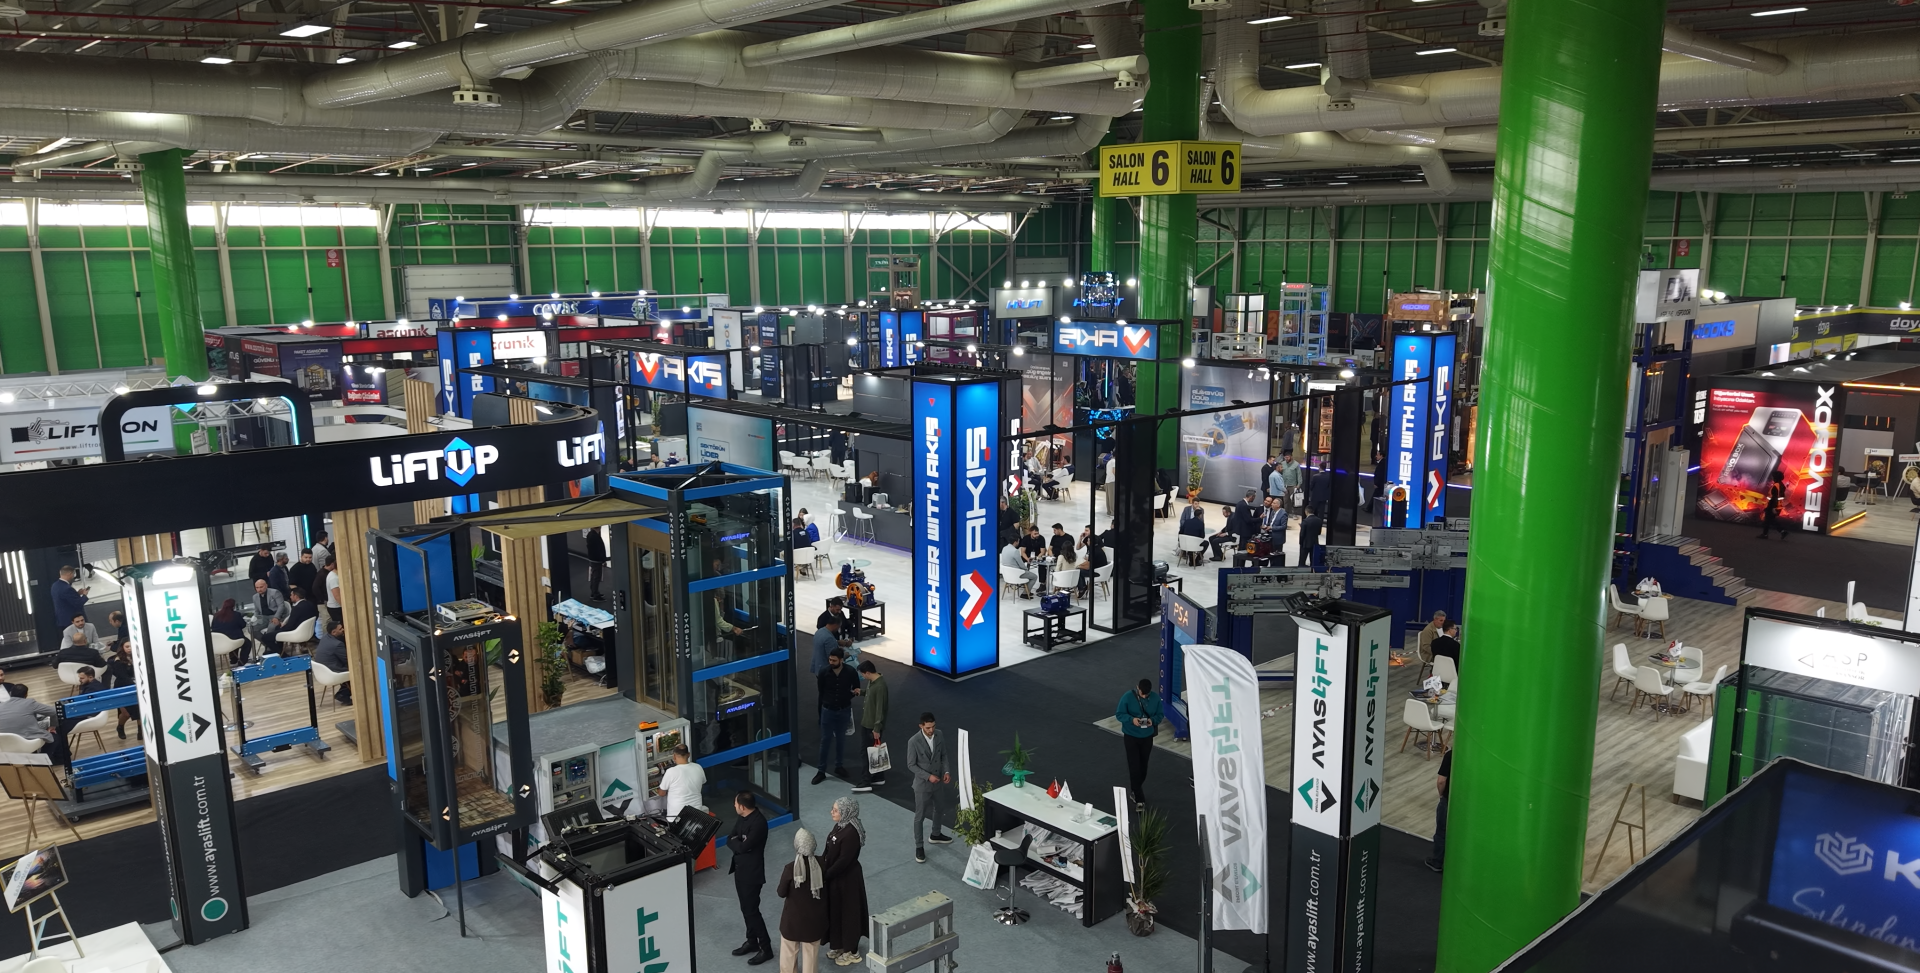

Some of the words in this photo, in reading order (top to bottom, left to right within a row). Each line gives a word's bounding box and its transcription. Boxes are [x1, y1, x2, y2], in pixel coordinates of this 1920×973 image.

[1109, 153, 1145, 169] SALON
[1151, 150, 1169, 186] 6
[1187, 150, 1216, 165] SALON
[1220, 150, 1235, 185] 6
[1112, 171, 1140, 186] HALL
[1190, 169, 1213, 183] HALL
[1401, 406, 1416, 449] WITH
[926, 482, 940, 542] WITH
[926, 546, 940, 639] HIGHER
[1173, 602, 1189, 626] PSA
[193, 776, 220, 897] www.ayaslift.com.tr
